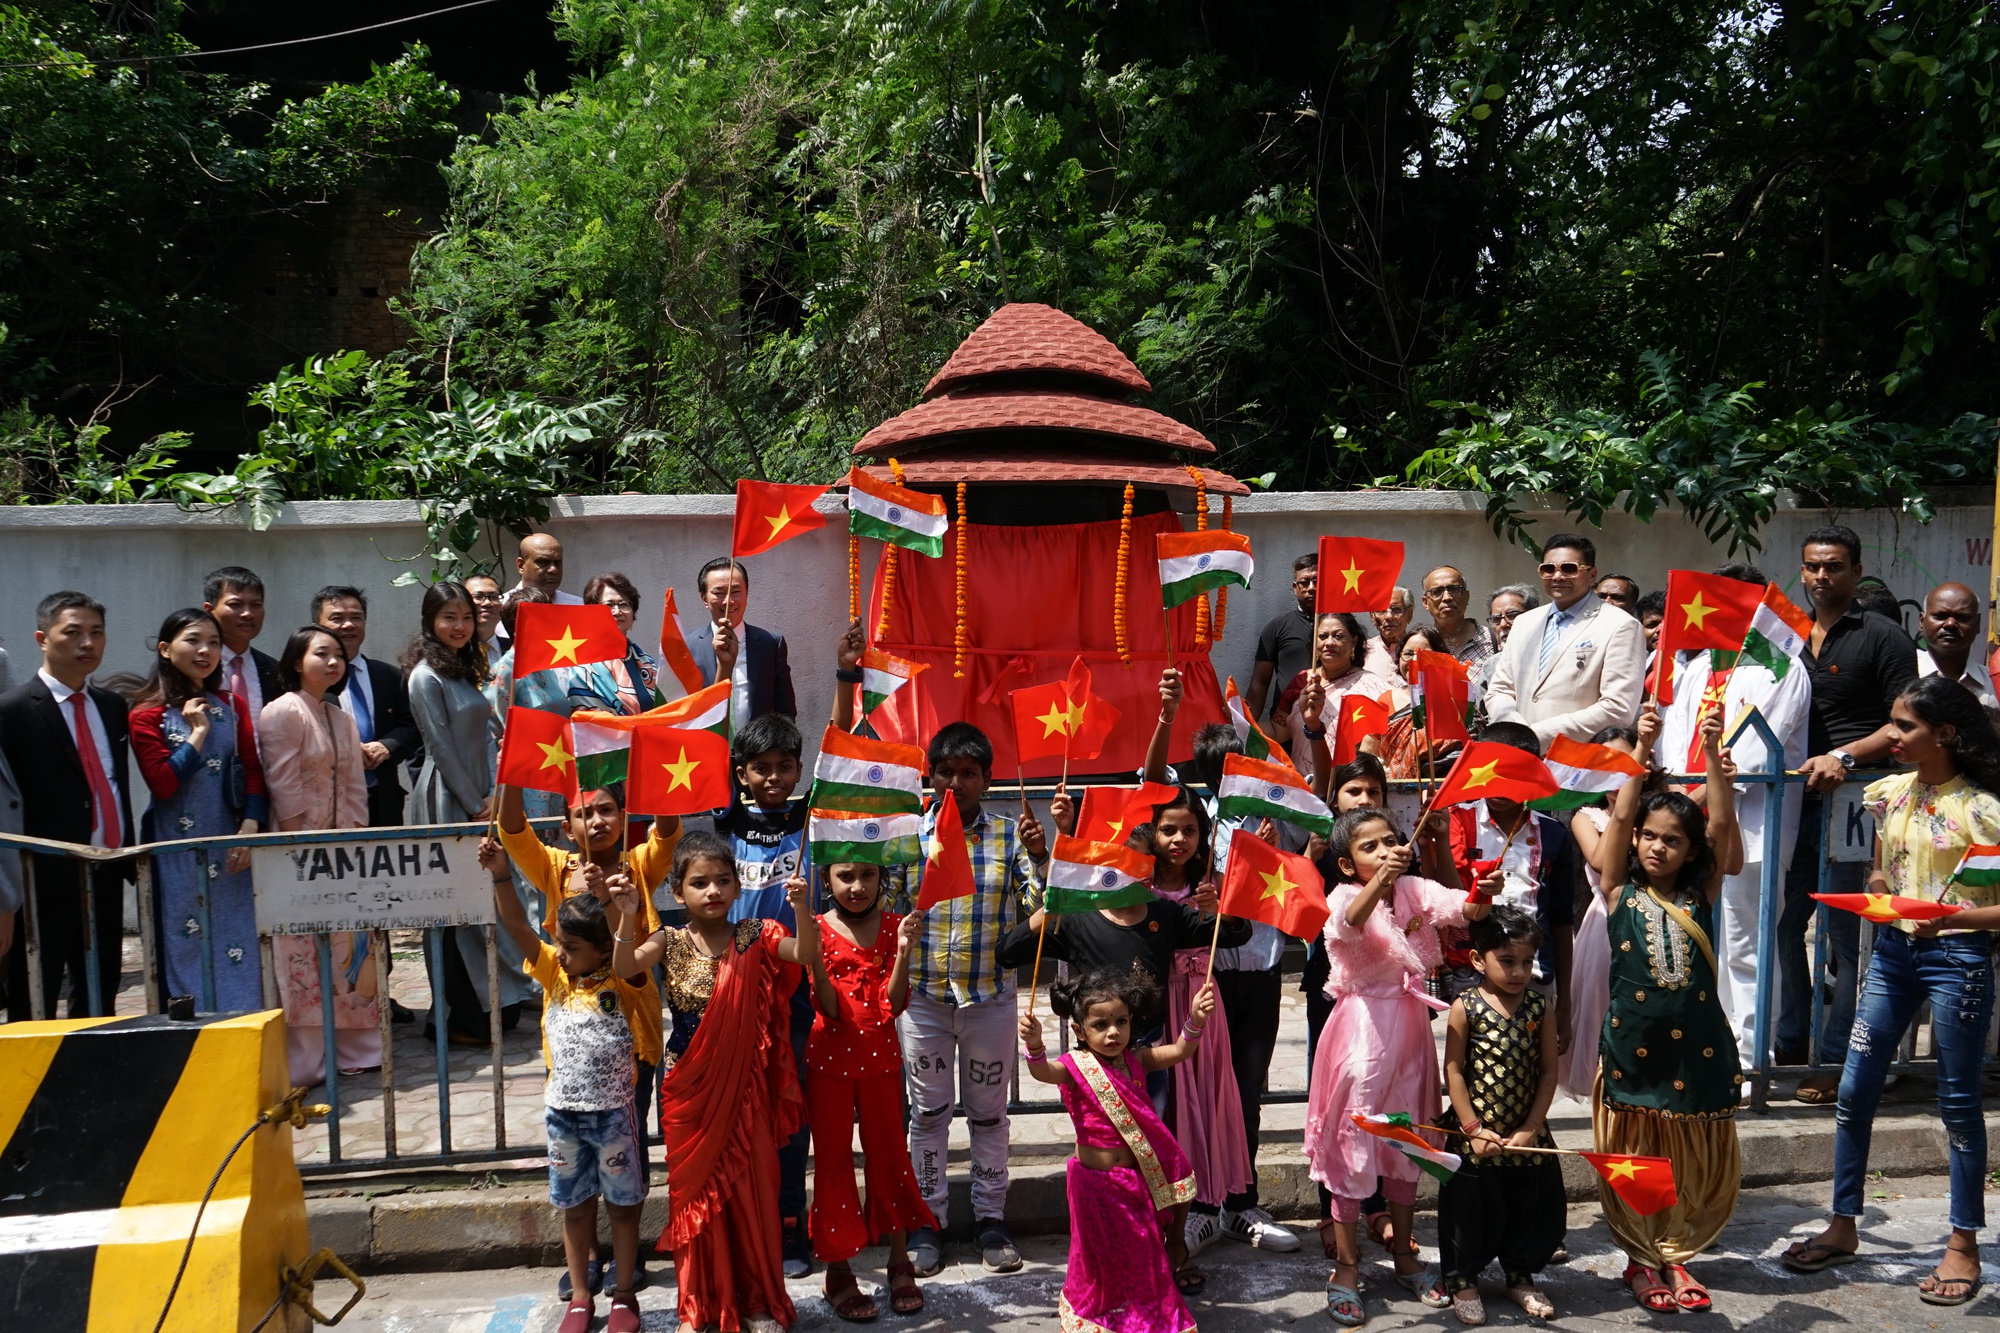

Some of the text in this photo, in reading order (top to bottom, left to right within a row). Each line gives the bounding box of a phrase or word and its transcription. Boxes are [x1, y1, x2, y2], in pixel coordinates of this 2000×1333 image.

[287, 842, 450, 881] YAMAHA
[289, 886, 456, 907] MUSIC SQUARE
[908, 1055, 946, 1077] USA
[969, 1058, 1003, 1086] 52
